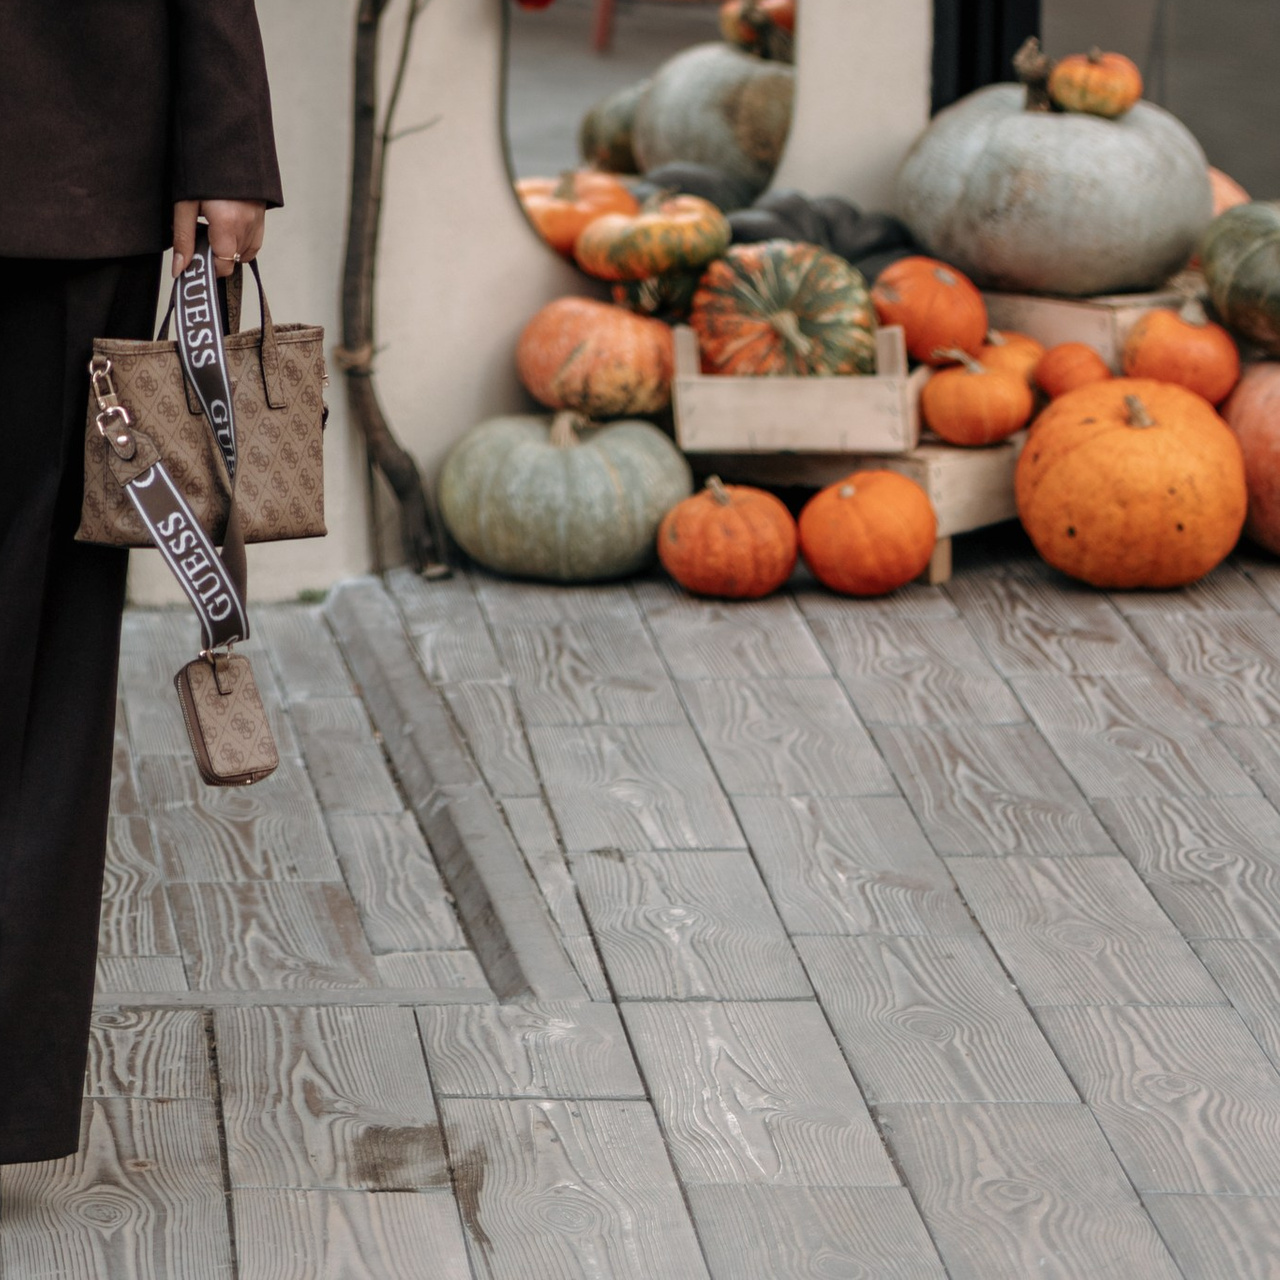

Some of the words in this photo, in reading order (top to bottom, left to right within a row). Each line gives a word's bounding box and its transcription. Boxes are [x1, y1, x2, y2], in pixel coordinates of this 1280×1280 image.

[184, 253, 217, 370] GUESS
[210, 399, 235, 474] GUE
[157, 511, 232, 622] GUESS
